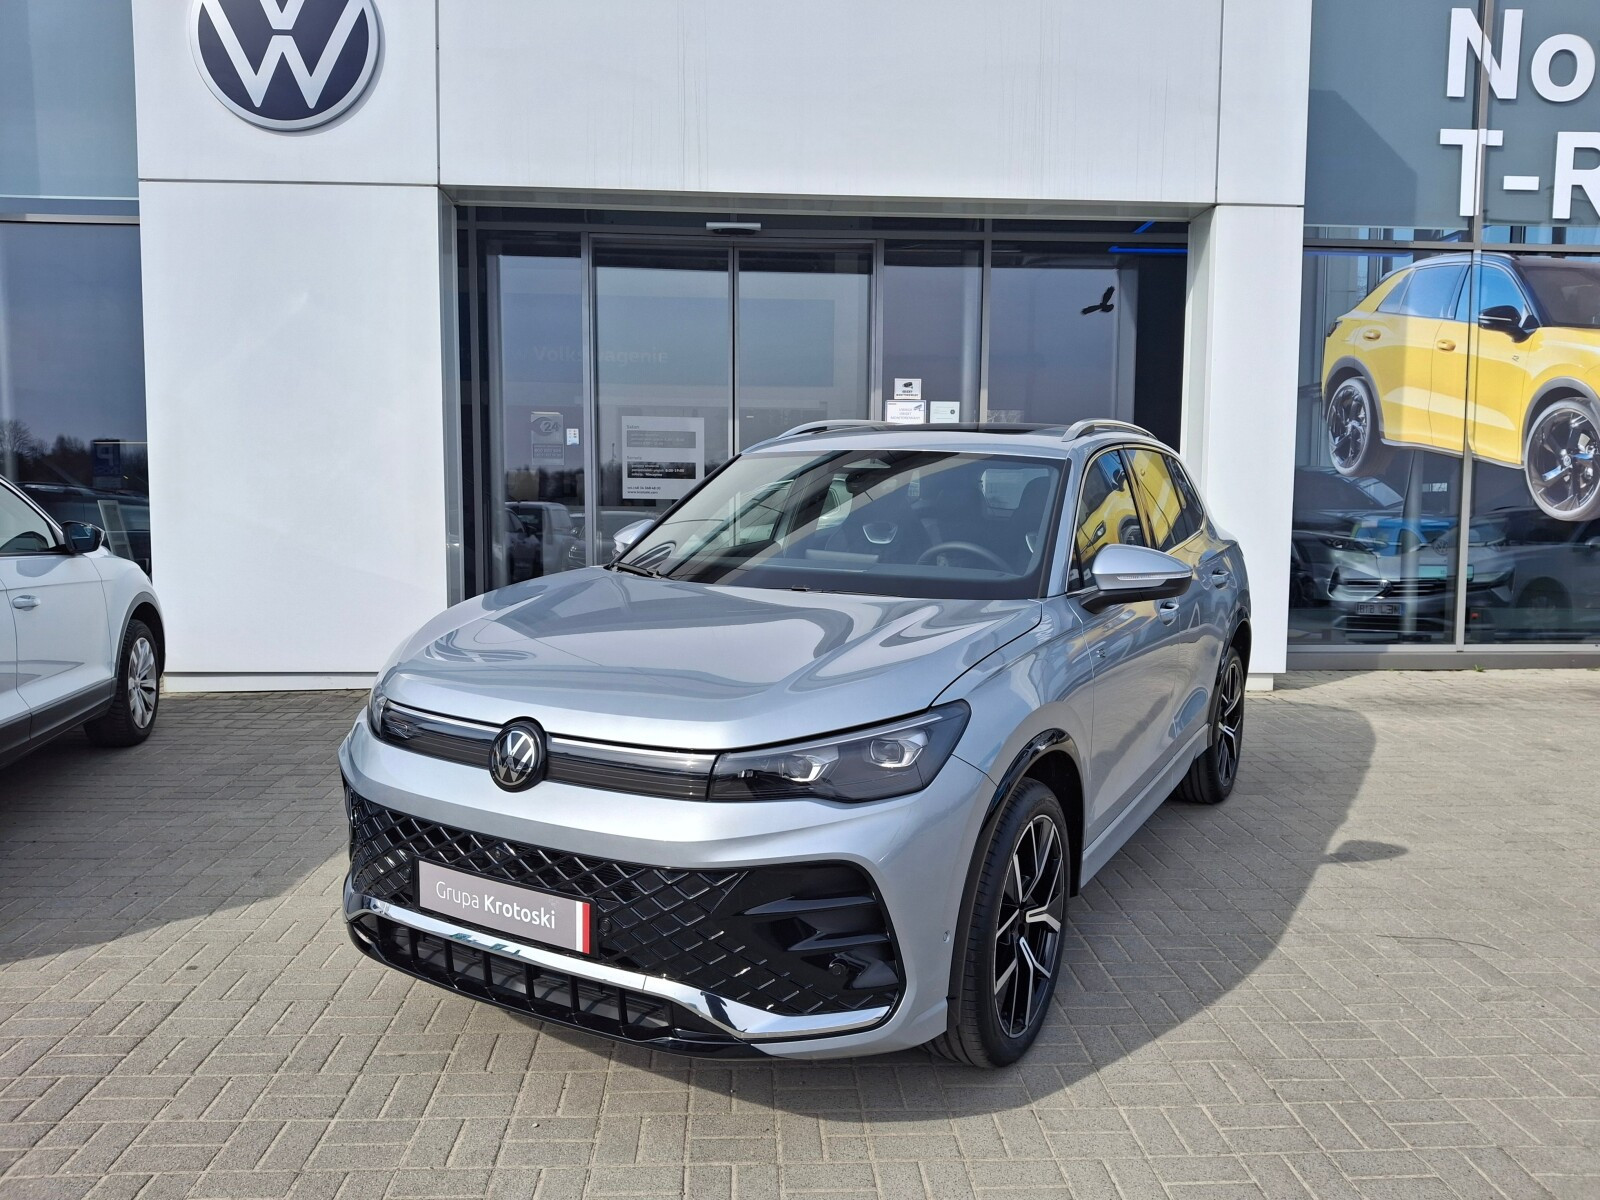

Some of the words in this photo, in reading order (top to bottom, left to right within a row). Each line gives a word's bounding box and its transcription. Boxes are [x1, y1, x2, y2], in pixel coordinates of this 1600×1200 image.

[1447, 8, 1596, 102] No
[1440, 128, 1600, 219] T-R
[436, 881, 480, 909] Grupa
[484, 894, 556, 929] Krotoski
